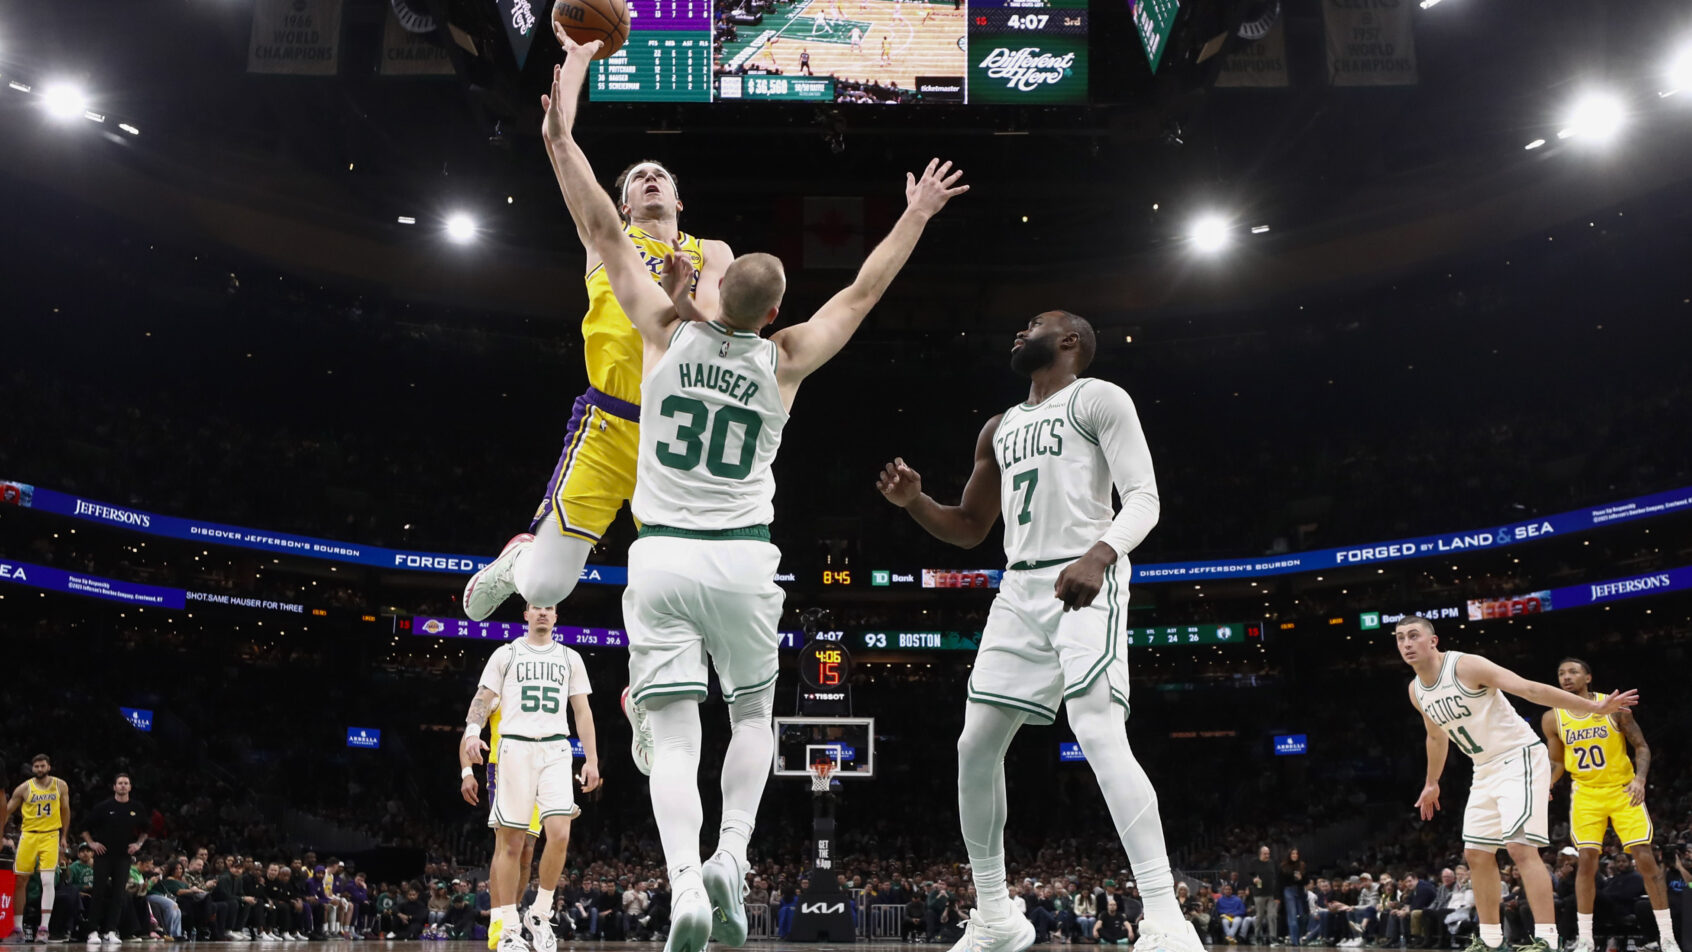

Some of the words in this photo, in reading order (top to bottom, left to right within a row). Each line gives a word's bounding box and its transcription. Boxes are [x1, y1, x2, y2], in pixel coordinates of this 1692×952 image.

[1008, 14, 1049, 29] 4:07
[1064, 17, 1081, 26] 3rd
[255, 47, 332, 61] CHAMPIONS
[388, 48, 448, 61] CHAMPIO
[979, 48, 1075, 70] Different
[988, 67, 1064, 91] Here
[679, 363, 759, 406] HAUSER
[656, 394, 763, 480] 30
[997, 418, 1064, 473] CELTICS
[1013, 468, 1038, 526] 7
[74, 499, 150, 528] JEFFERSON'S
[191, 526, 241, 540] DISCOVER
[245, 535, 310, 550] JEFFERSON'S
[314, 544, 360, 557] BOURBON
[1336, 543, 1416, 563] FORGED
[1420, 543, 1434, 551] BY
[1438, 533, 1493, 550] LAND
[1515, 522, 1554, 539] SEA
[0, 564, 27, 580] EA
[395, 554, 473, 570] FORGED
[580, 569, 601, 580] EA
[1140, 568, 1186, 576] DISCOVER
[1188, 564, 1252, 574] JEFFERSON'S
[1255, 560, 1301, 570] BOURBON
[823, 571, 850, 584] 8:45
[874, 573, 888, 582] TD
[892, 574, 914, 583] Bank
[1590, 574, 1670, 600] JEFFERSON'S
[230, 597, 261, 608] HAUSER
[262, 600, 278, 609] FOR
[280, 603, 304, 613] THREE
[1363, 615, 1378, 626] TD
[1441, 608, 1459, 618] PM
[458, 628, 468, 636] 24
[481, 629, 487, 637] 8
[577, 635, 598, 644] 21/53
[606, 637, 620, 645] 39.6
[778, 633, 793, 647] 71
[816, 632, 844, 641] 4:07
[865, 634, 887, 648] 93
[900, 633, 941, 647] BOSTON
[816, 651, 841, 662] 4:06
[516, 661, 566, 686] CELTICS
[819, 663, 839, 685] 15
[521, 685, 560, 714] 55
[1424, 695, 1472, 726] ELTICS
[1449, 726, 1484, 754] 11
[1565, 726, 1609, 745] LAKERS
[1573, 745, 1606, 769] 20
[31, 794, 57, 803] LAKERS
[37, 803, 51, 817] 14
[818, 840, 829, 849] GET
[818, 850, 829, 858] THE
[821, 859, 832, 870] App
[2, 893, 11, 908] tv
[802, 902, 845, 914] KIA
